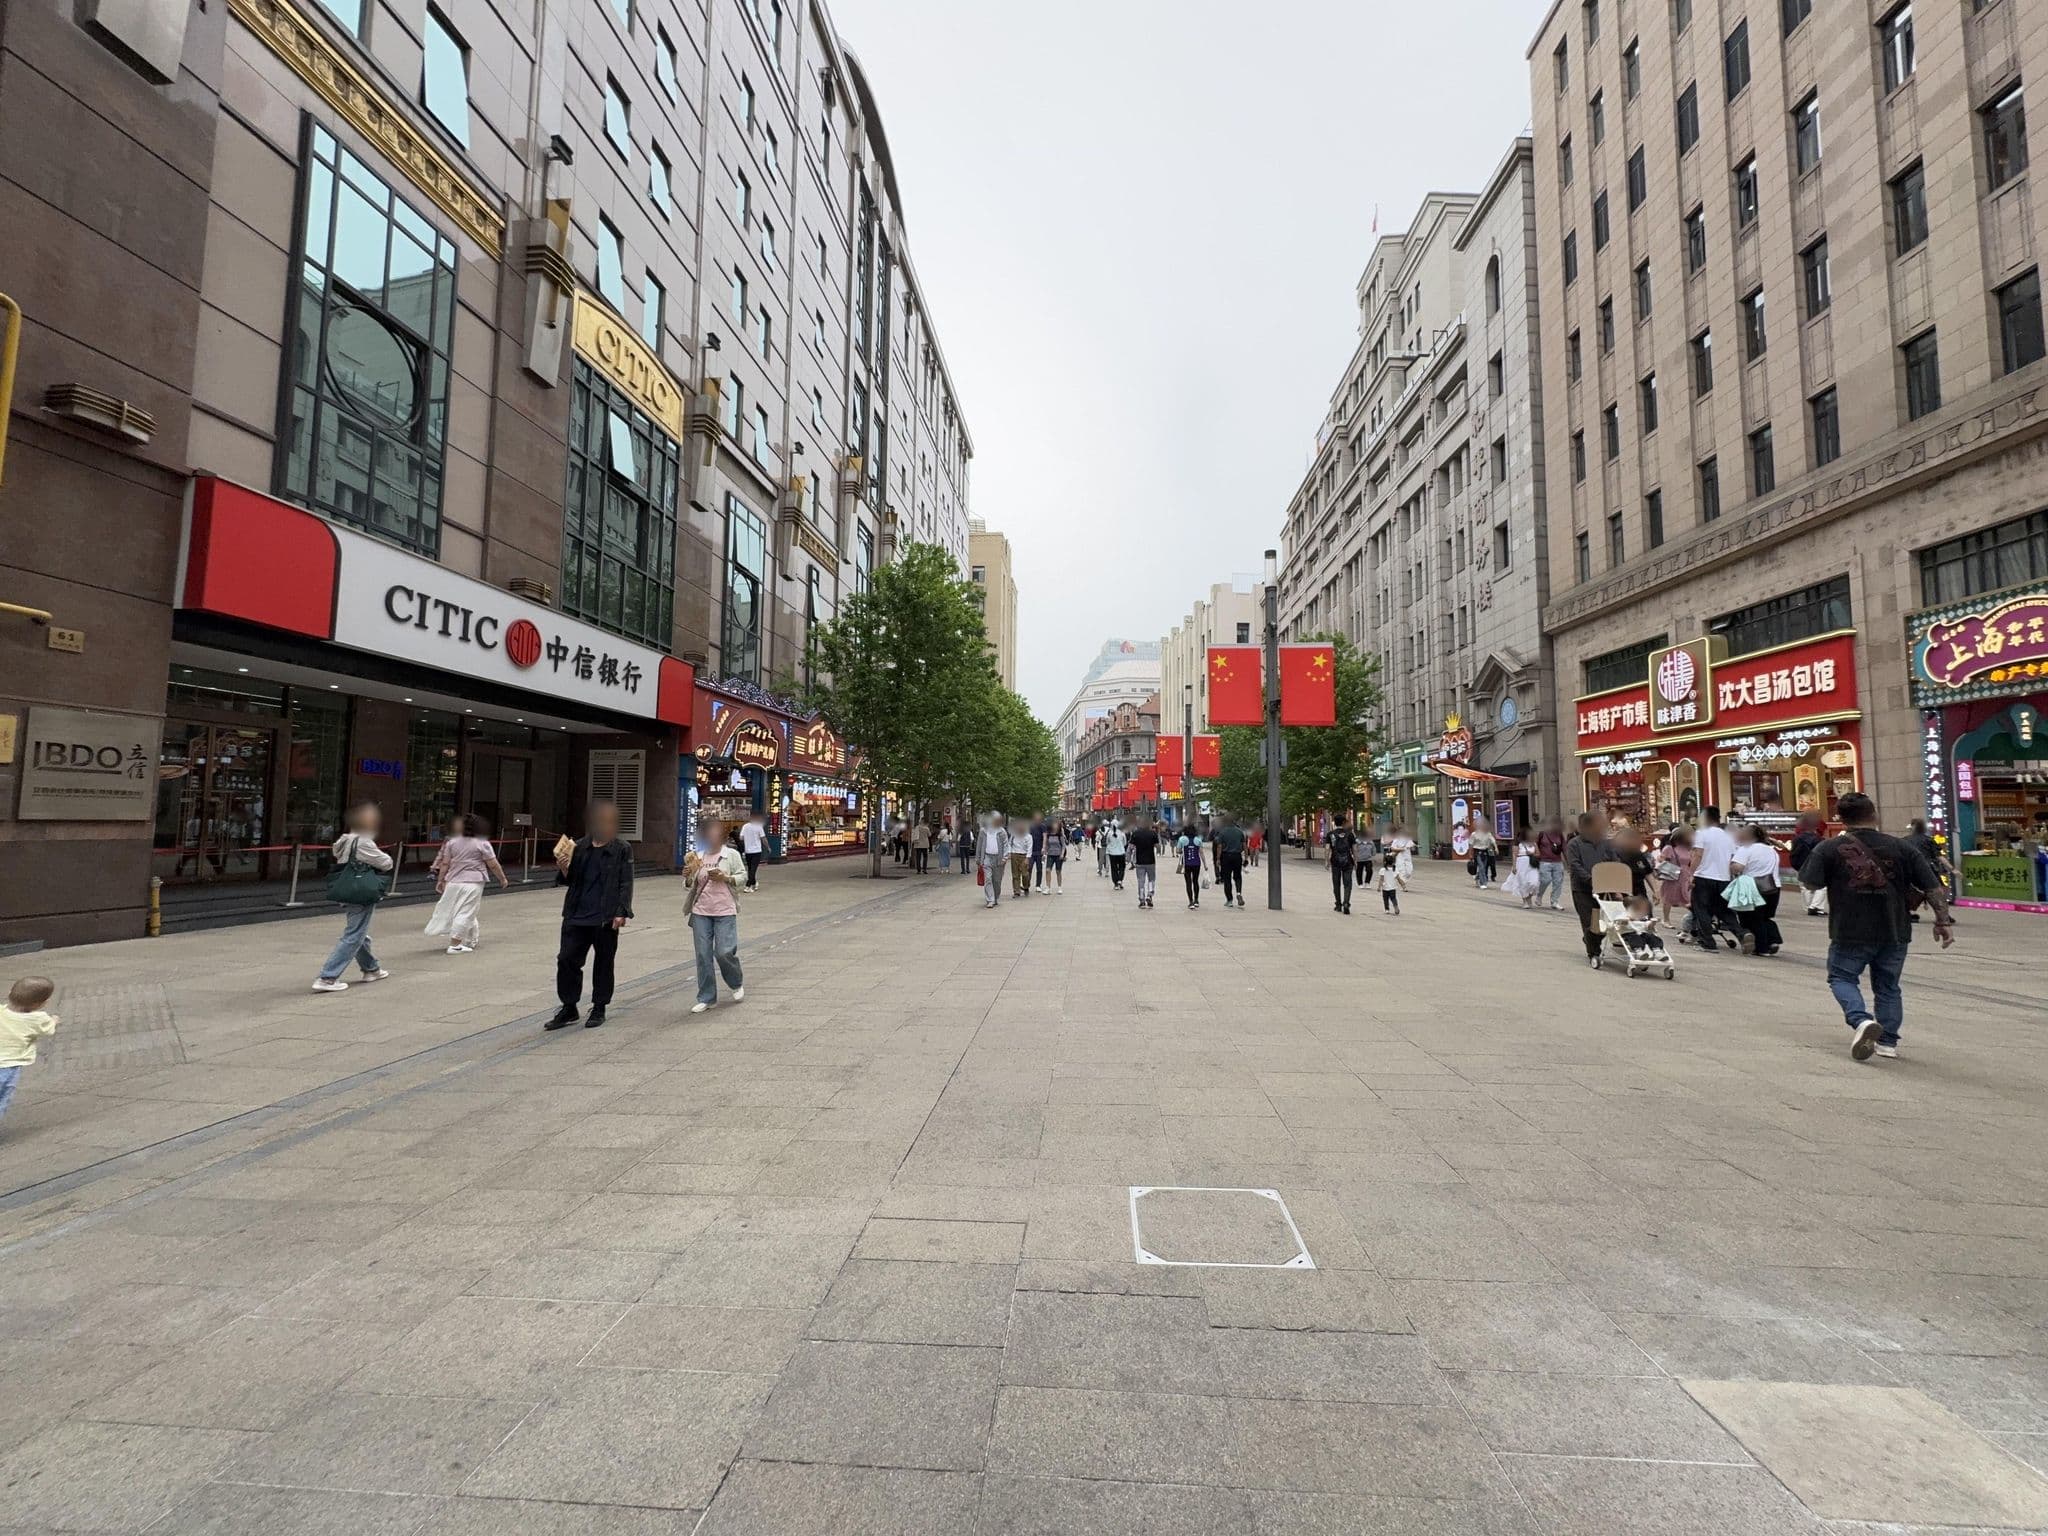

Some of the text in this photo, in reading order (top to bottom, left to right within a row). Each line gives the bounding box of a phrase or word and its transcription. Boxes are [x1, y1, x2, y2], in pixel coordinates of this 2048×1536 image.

[596, 325, 668, 413] CITIC
[384, 585, 499, 650] CITIC
[546, 635, 643, 694] 中信银行
[1946, 627, 2006, 670] 上海
[1719, 659, 1836, 711] 沈大昌汤包馆
[1577, 700, 1649, 736] 上海特产市集
[1657, 702, 1697, 725] 味津香
[126, 743, 149, 780] 立信
